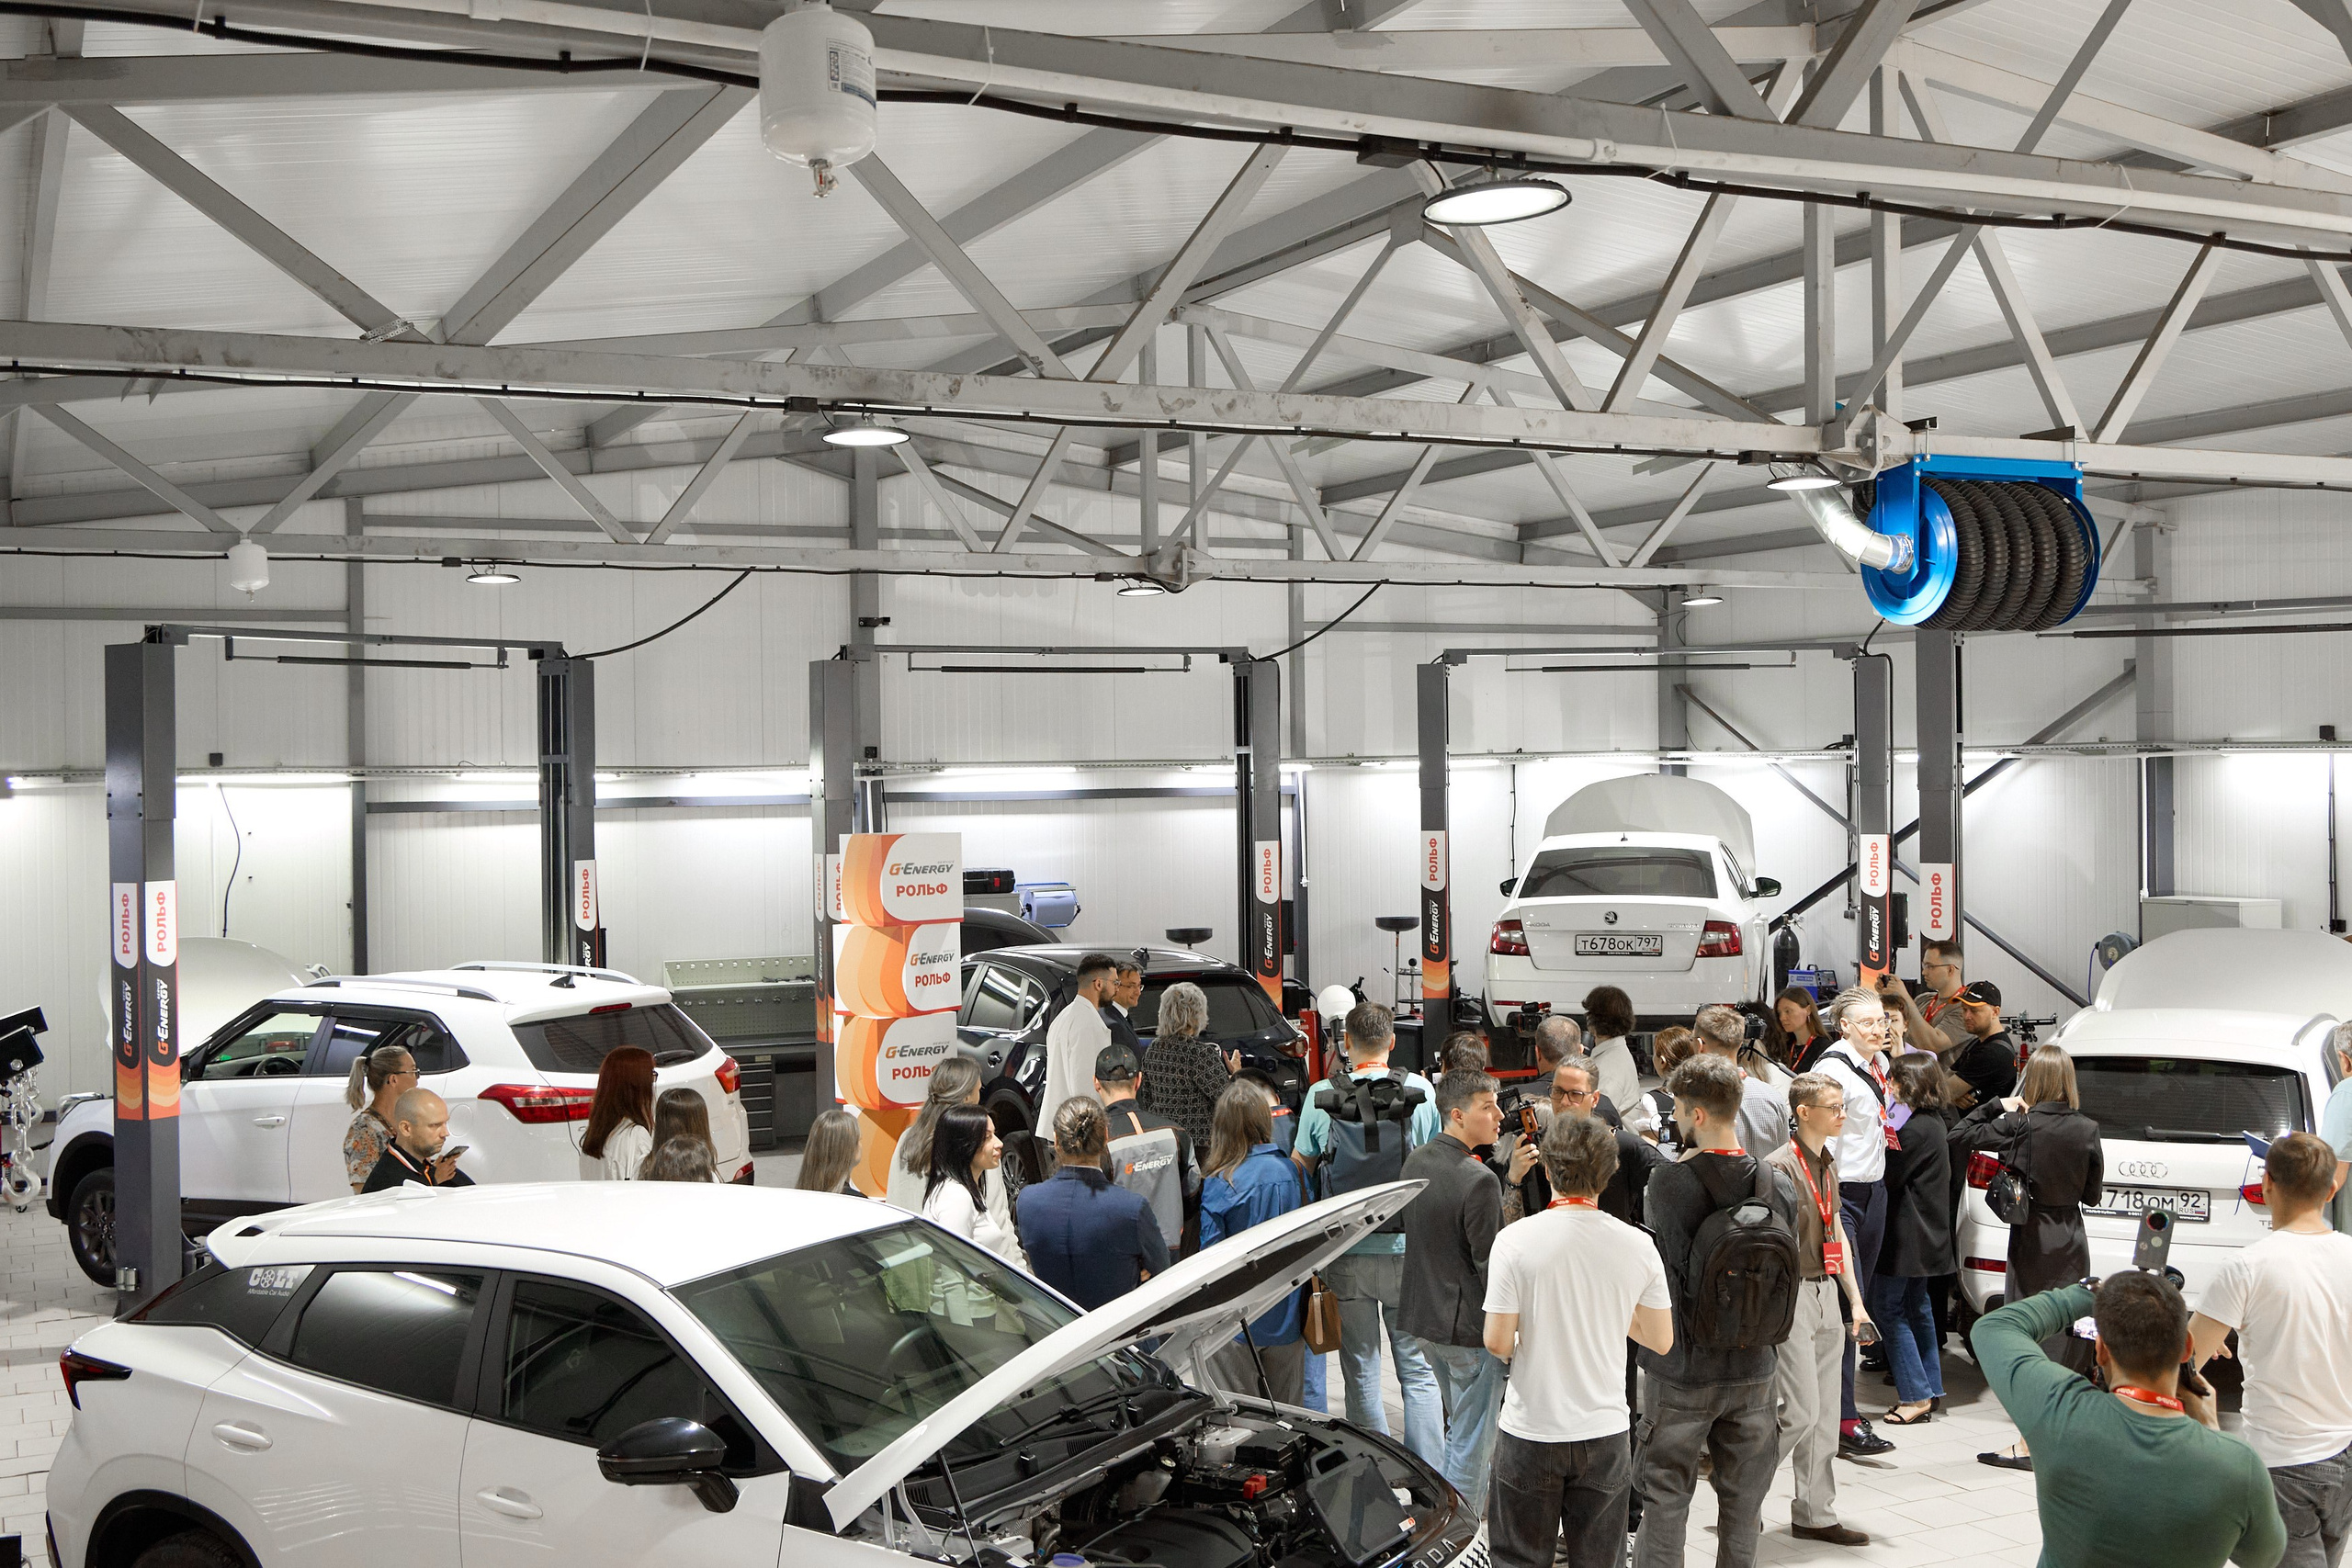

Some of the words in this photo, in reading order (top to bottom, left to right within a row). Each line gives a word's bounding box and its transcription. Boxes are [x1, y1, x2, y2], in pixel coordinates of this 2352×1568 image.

[1263, 848, 1272, 894] РОЛЬФ
[1430, 838, 1438, 882] РОЛЬФ
[1870, 841, 1879, 886] РОЛЬФ
[582, 868, 590, 919] РОЛЬФ
[896, 883, 948, 897] РОЛЬФ
[1930, 872, 1942, 929] РОЛЬФ
[121, 893, 130, 954] РОЛЬФ
[156, 891, 167, 953] РОЛЬФ
[1637, 937, 1658, 947] 797
[915, 972, 951, 987] РОЛЬФ
[2098, 1190, 2174, 1211] 718ОМ
[2180, 1193, 2200, 1208] 92
[249, 1268, 299, 1288] COLT
